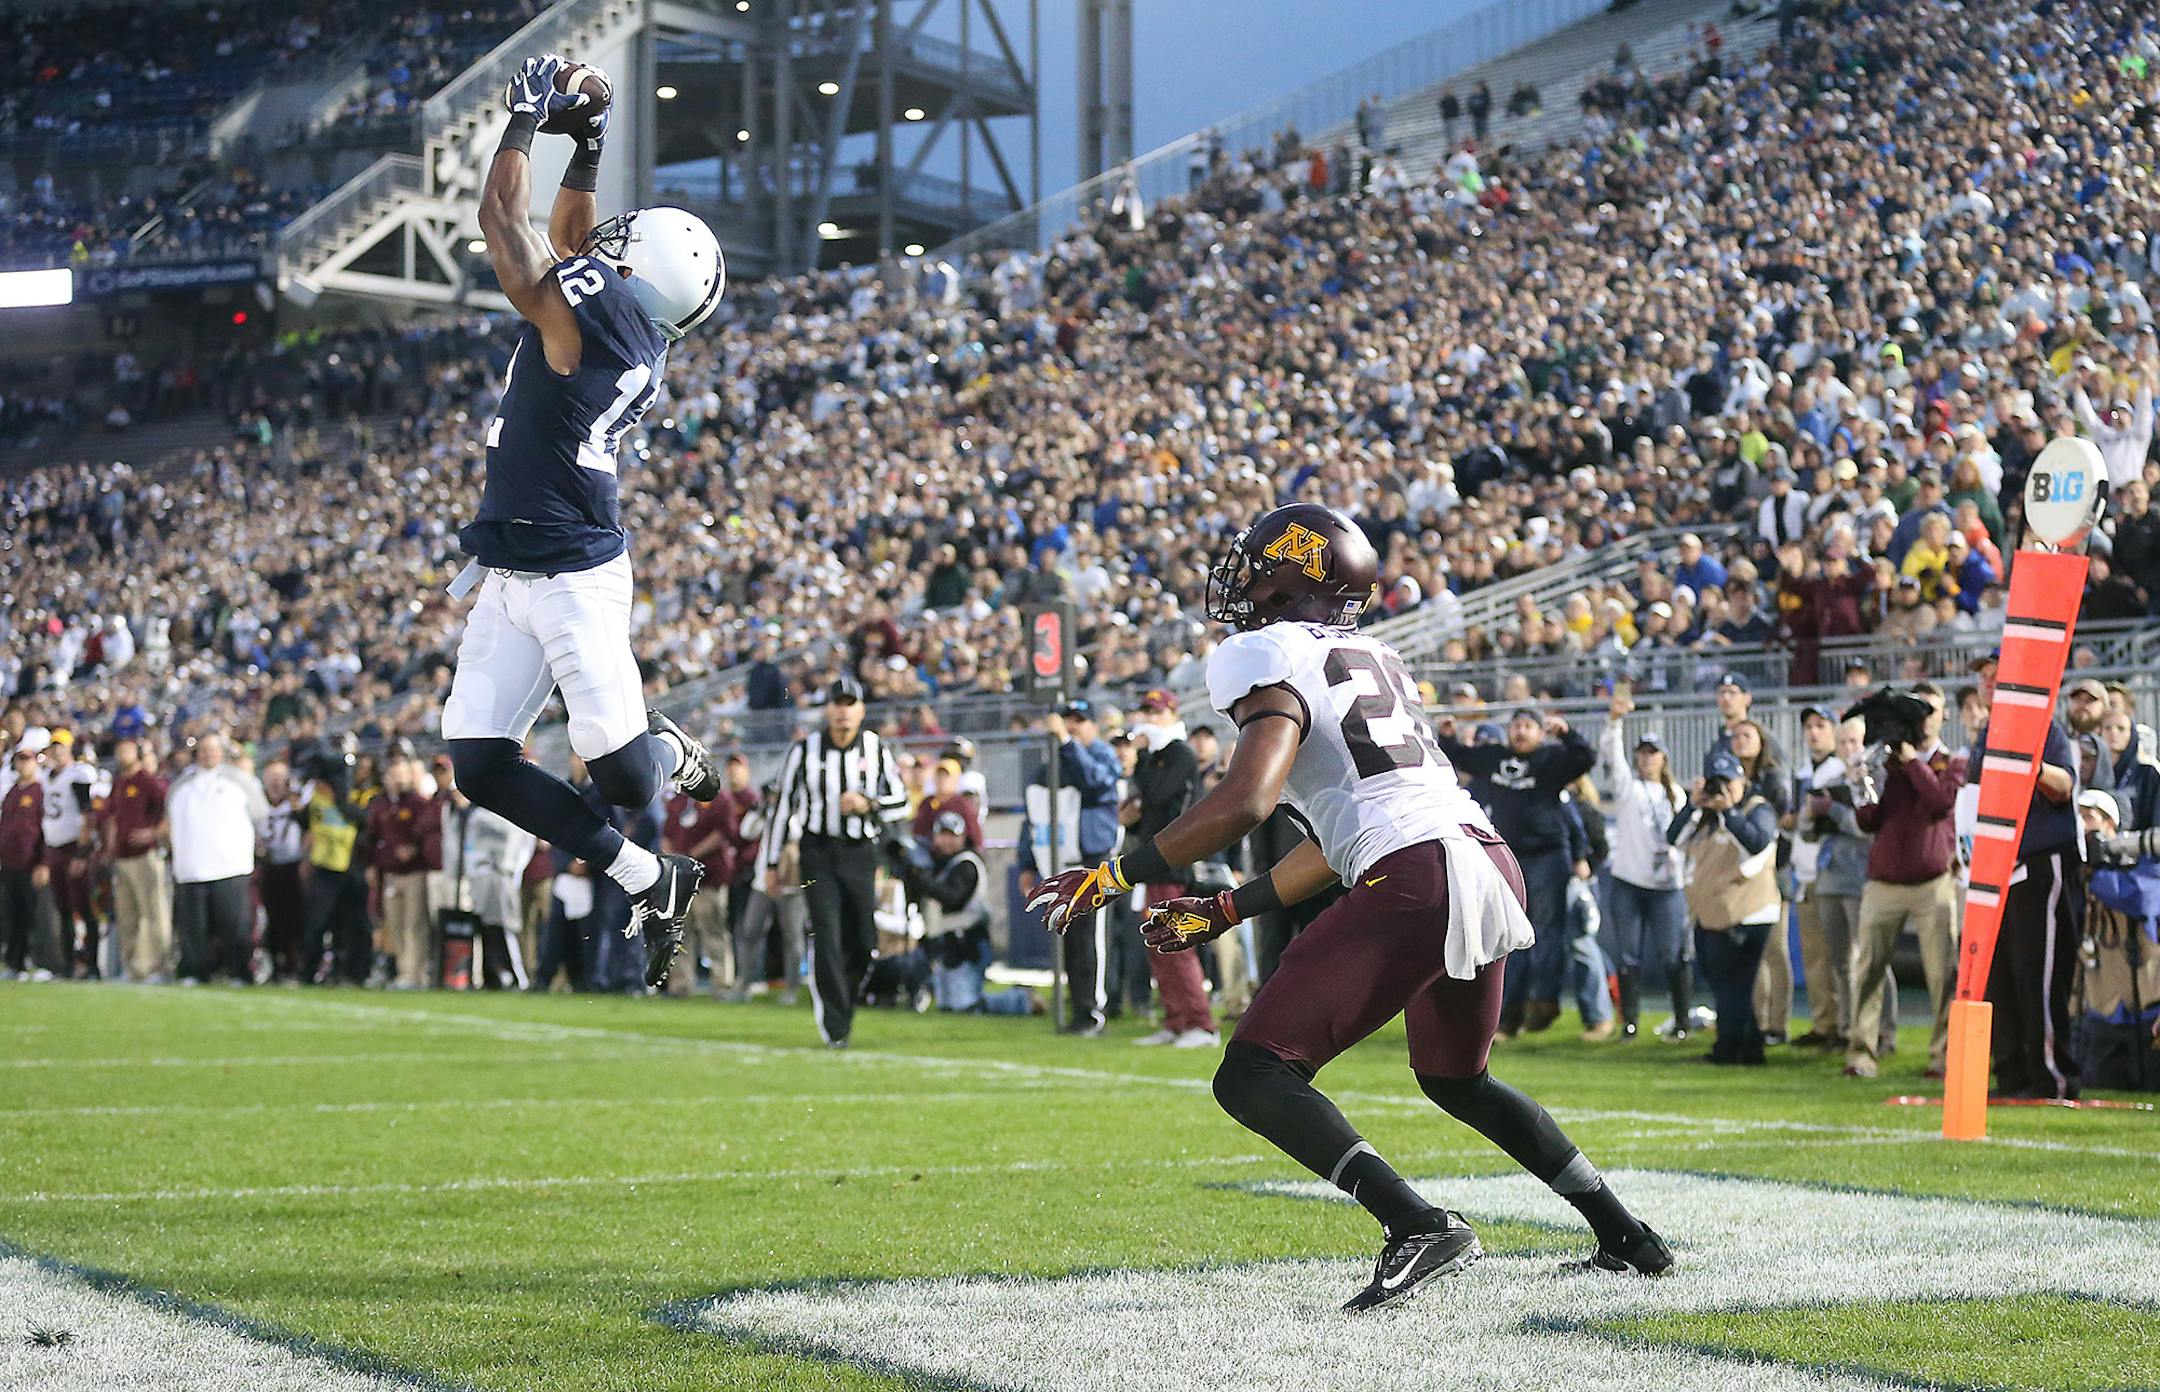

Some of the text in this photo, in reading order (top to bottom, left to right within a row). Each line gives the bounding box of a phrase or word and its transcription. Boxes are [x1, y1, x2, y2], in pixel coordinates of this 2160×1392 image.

[556, 258, 606, 308] 12
[1263, 522, 1330, 582] M
[1033, 611, 1062, 677] 3
